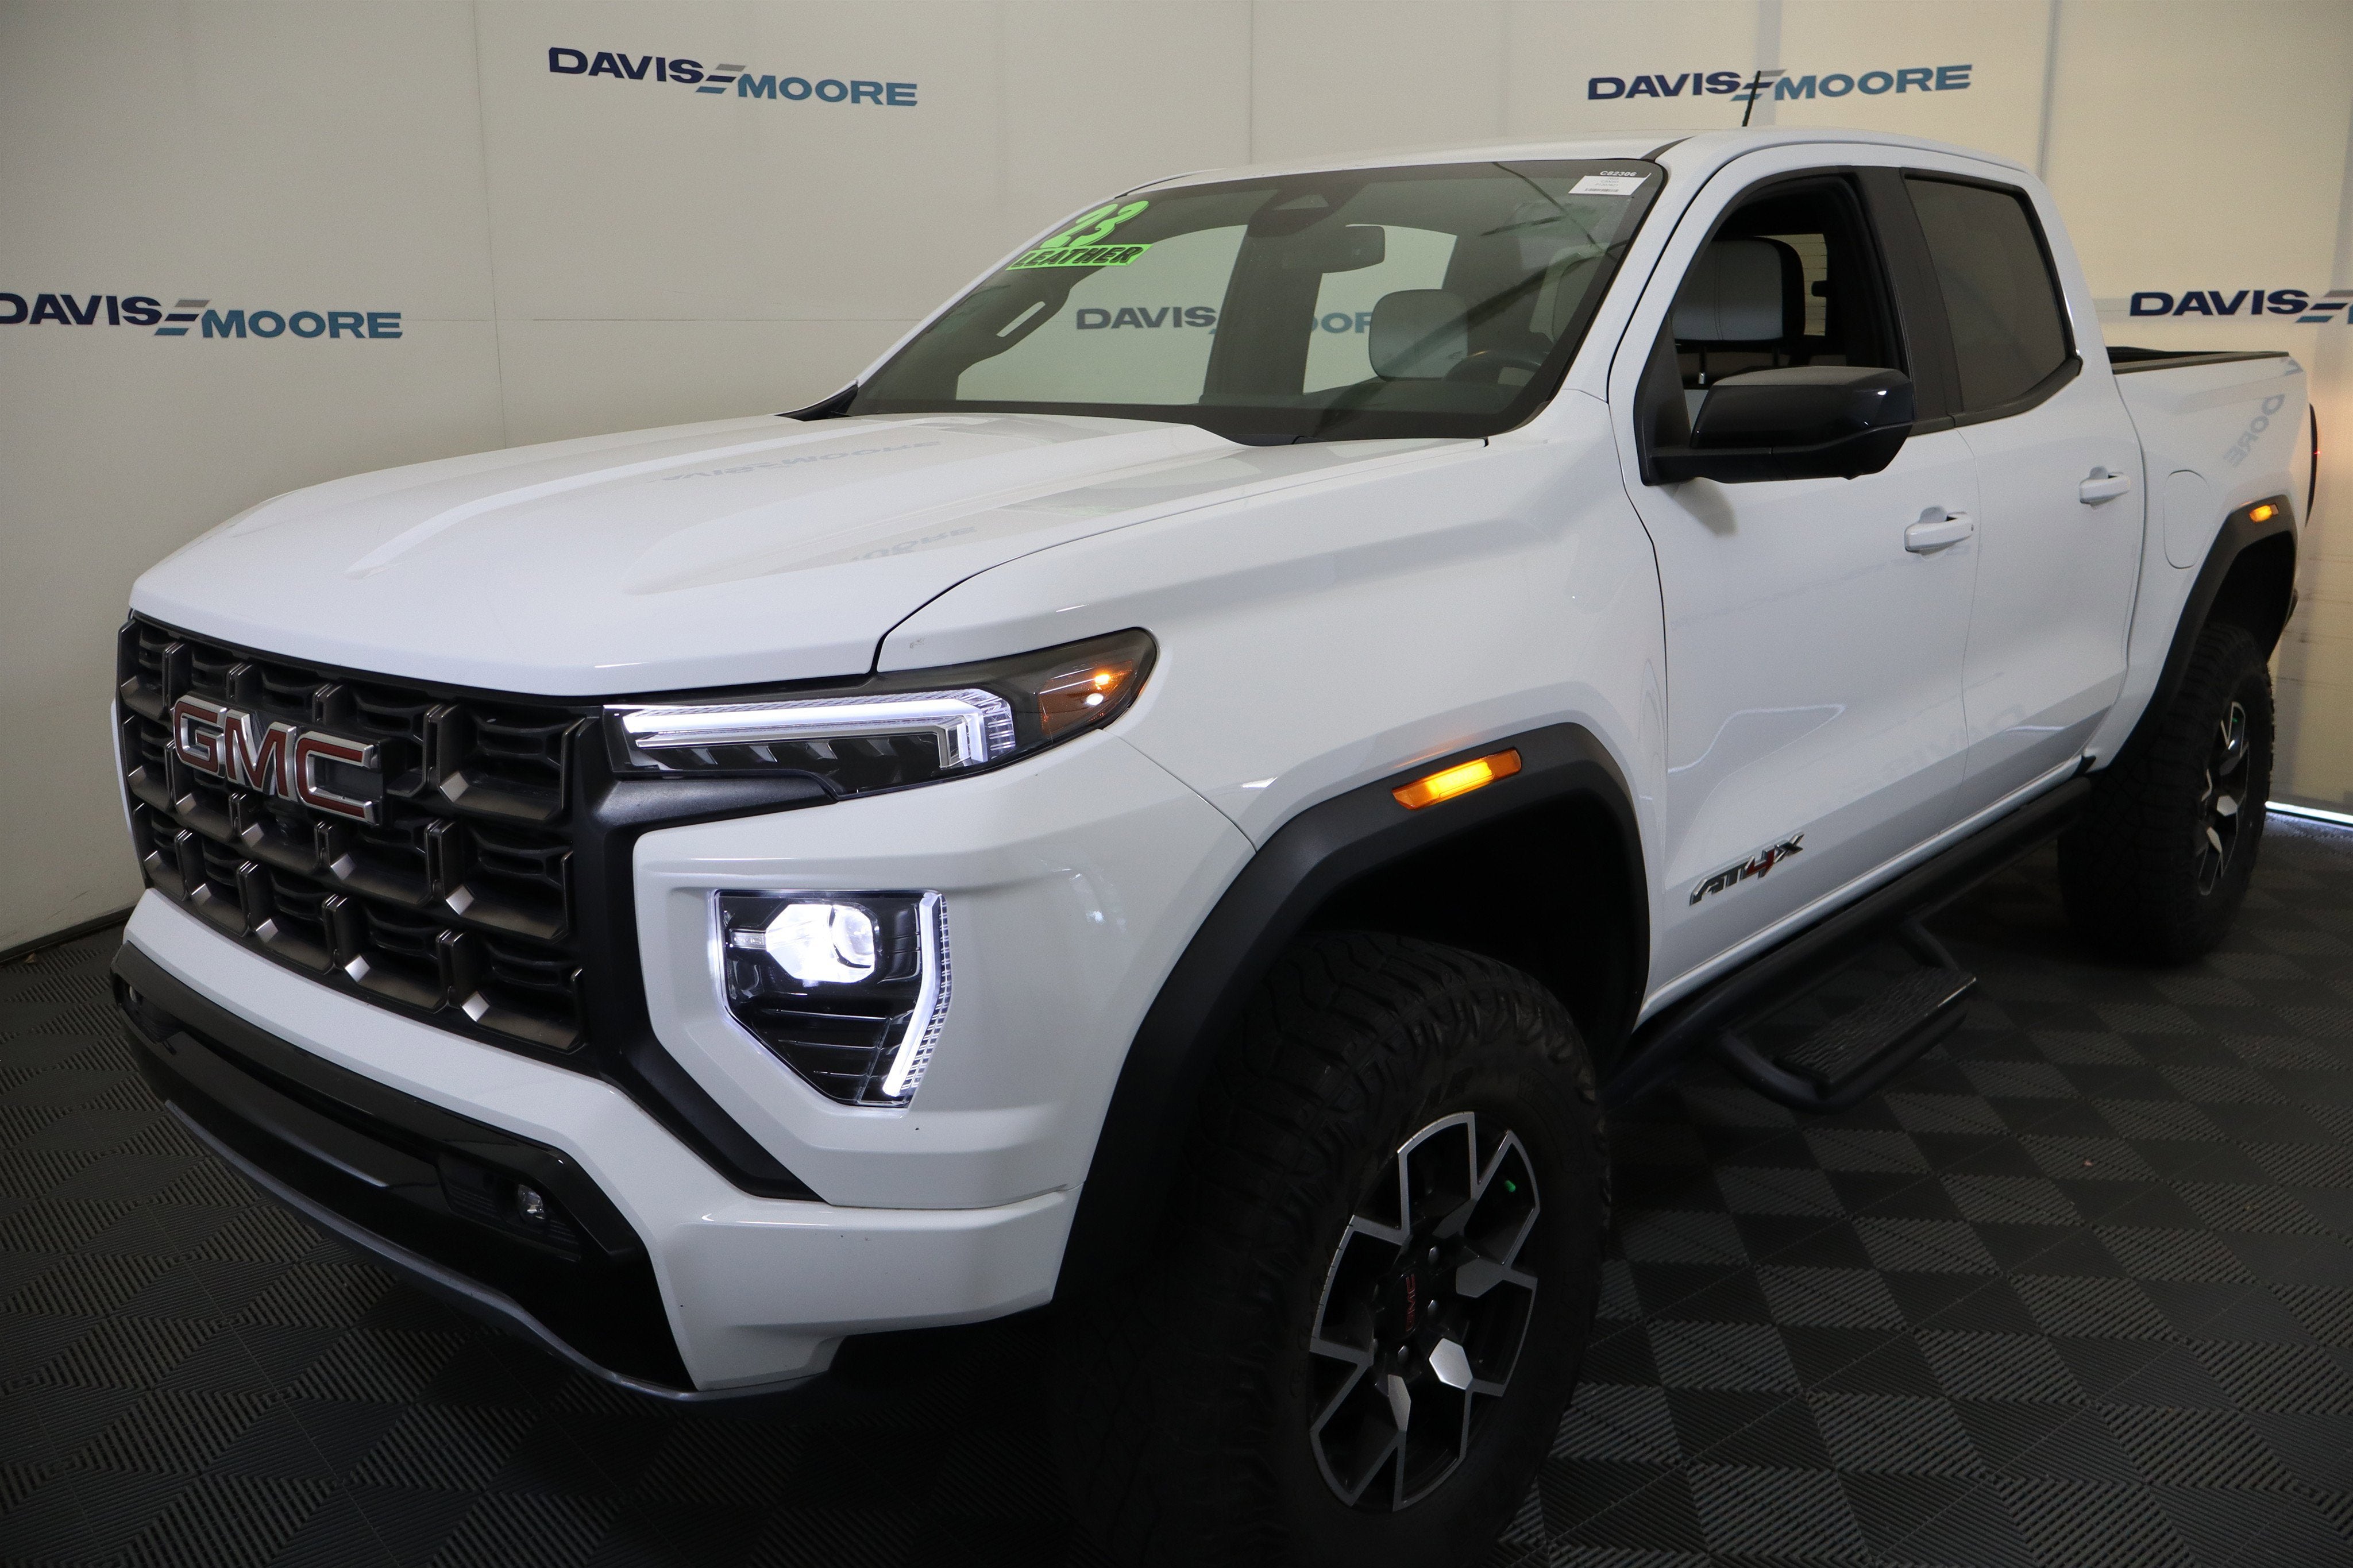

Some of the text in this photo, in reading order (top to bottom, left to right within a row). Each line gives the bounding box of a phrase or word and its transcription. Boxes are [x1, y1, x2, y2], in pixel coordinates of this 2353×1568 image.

[548, 47, 918, 106] DAVIS MOORE
[1587, 64, 1972, 101] DAVIS MOORE
[1010, 246, 1144, 268] LEATHER
[0, 293, 402, 338] DAVIS MOORE
[1076, 306, 1216, 330] DAVIS
[2130, 289, 2309, 316] DAVIS
[174, 694, 379, 826] GMC
[1689, 831, 1805, 906] AT4X
[1406, 1273, 1416, 1333] GMC
